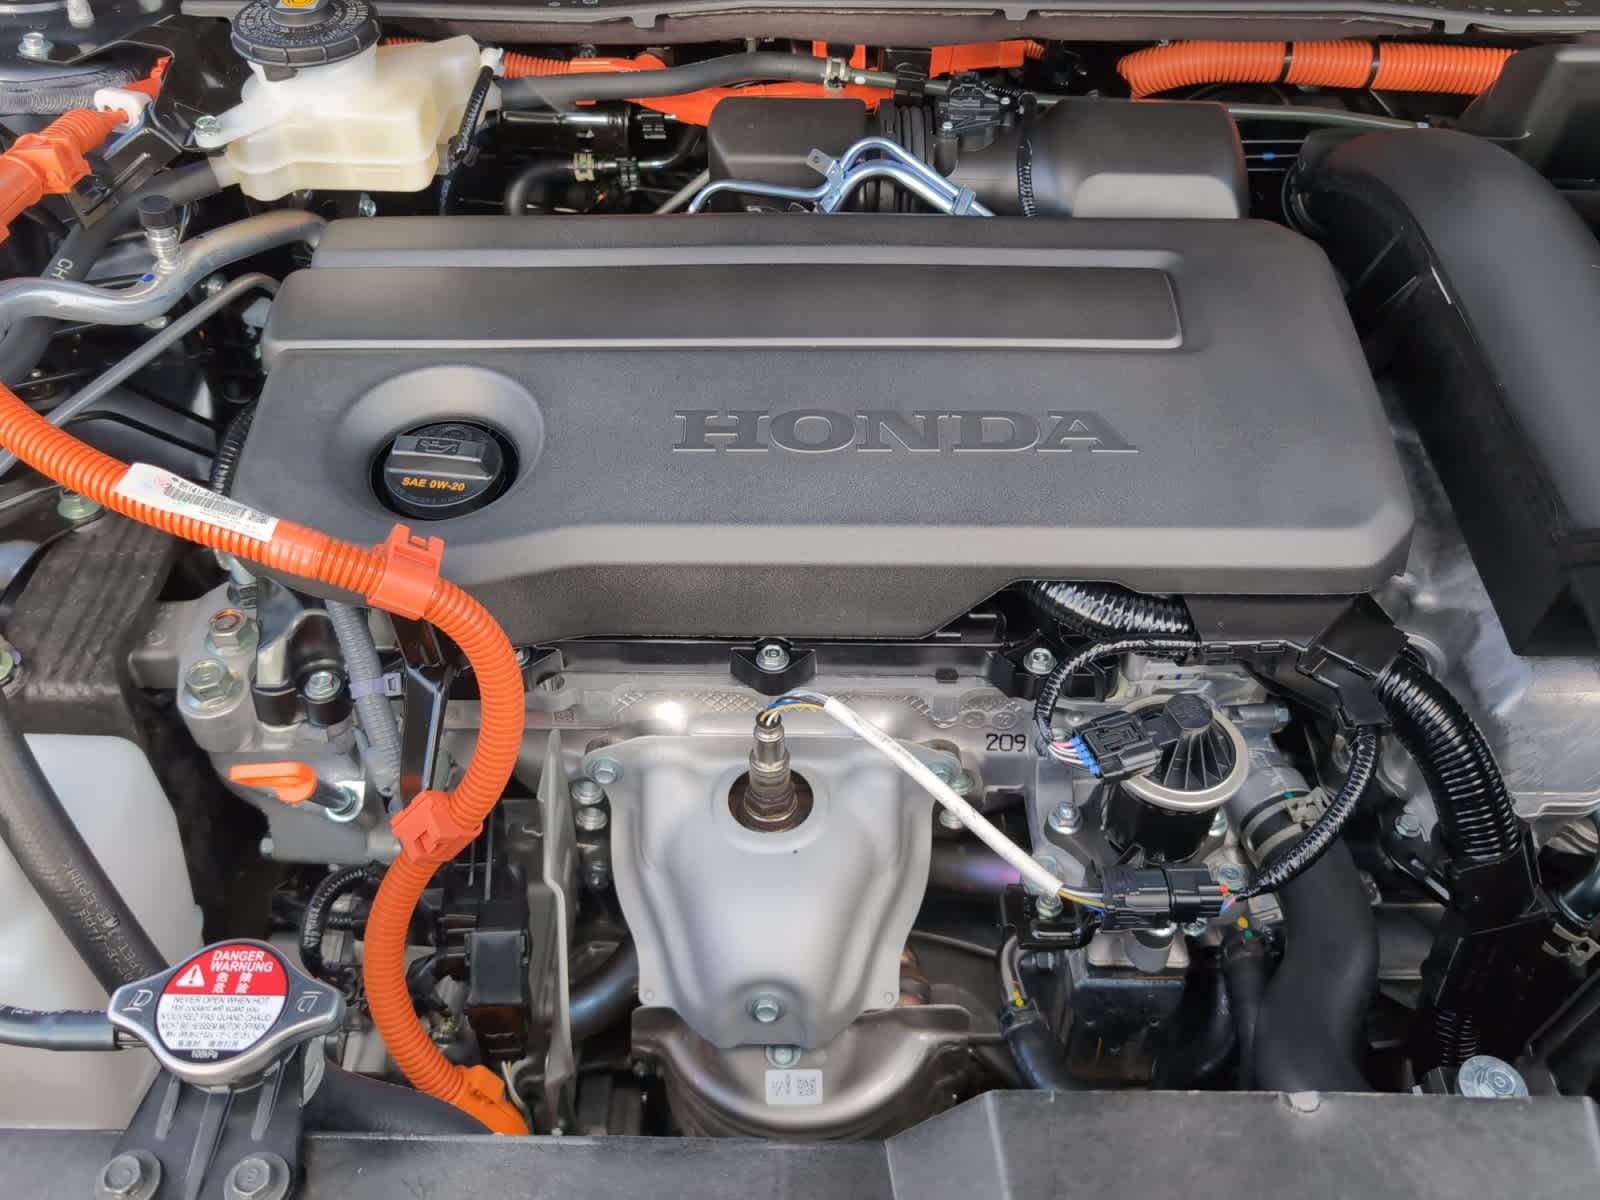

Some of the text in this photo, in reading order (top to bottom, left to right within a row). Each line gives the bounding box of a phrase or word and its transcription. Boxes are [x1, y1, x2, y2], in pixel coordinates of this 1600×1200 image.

[672, 408, 1140, 454] HONDA
[401, 476, 466, 492] SAE 0W-20
[986, 733, 1026, 753] 209
[213, 950, 265, 961] DANGER
[211, 961, 274, 972] WARNUNG
